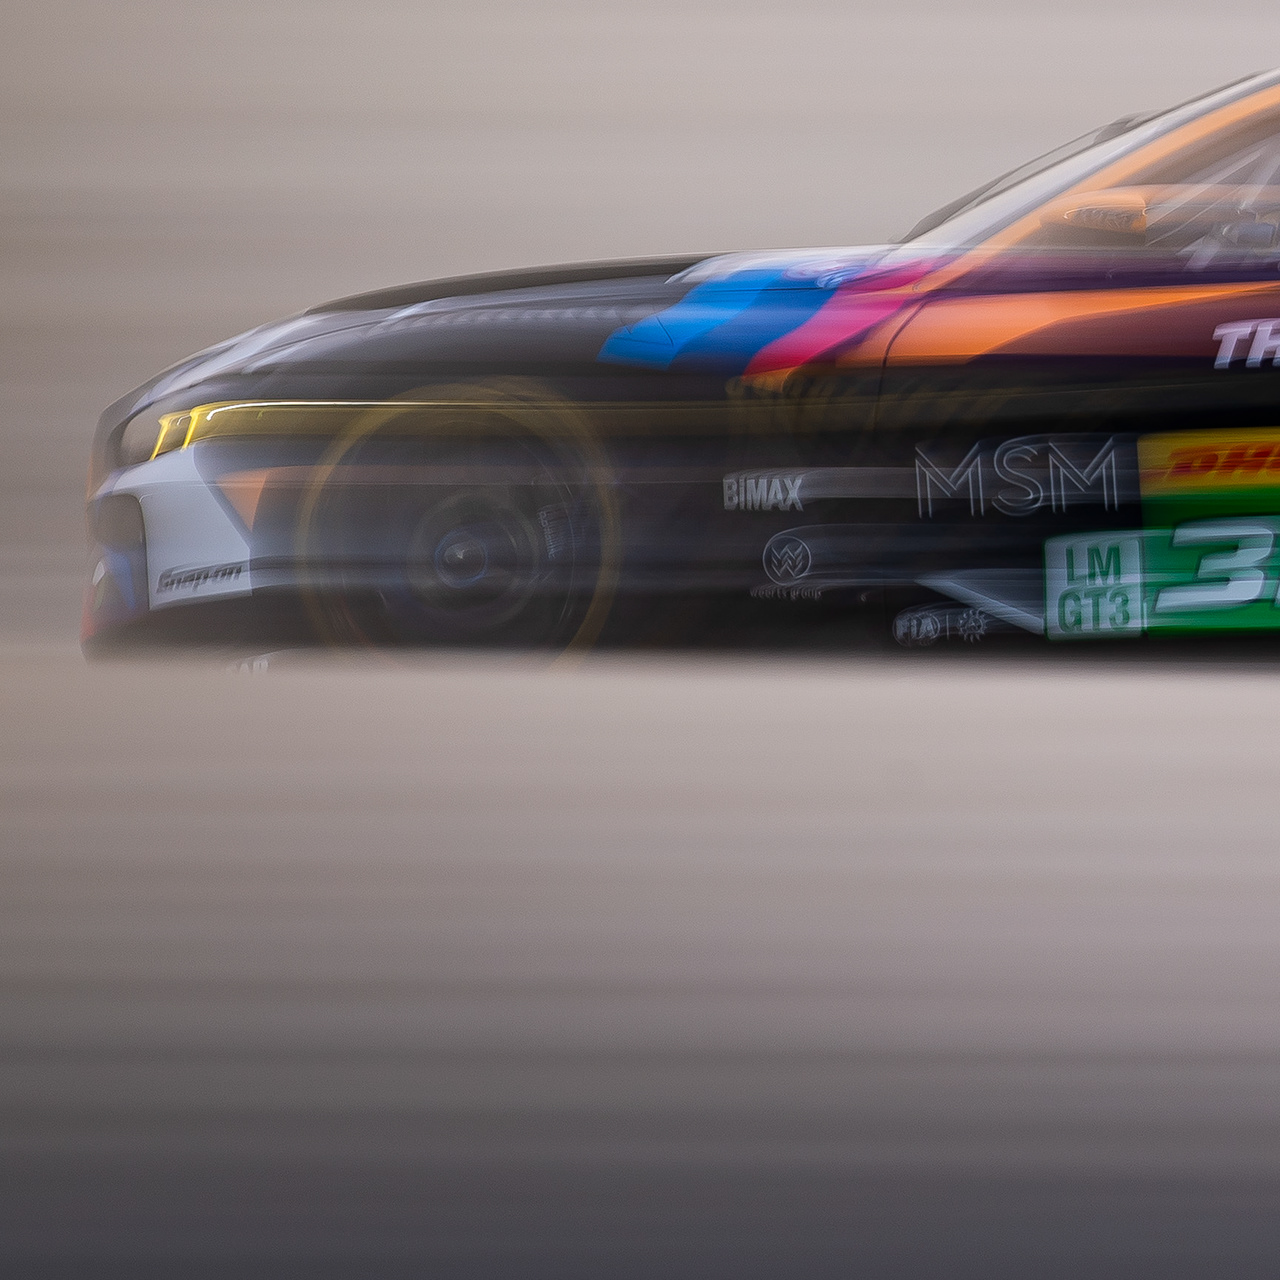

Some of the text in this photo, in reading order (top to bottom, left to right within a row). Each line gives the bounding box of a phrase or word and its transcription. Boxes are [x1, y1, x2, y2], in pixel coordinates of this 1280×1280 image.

[914, 436, 1120, 518] MSM
[1064, 545, 1121, 585] LM
[1057, 591, 1131, 635] GT3
